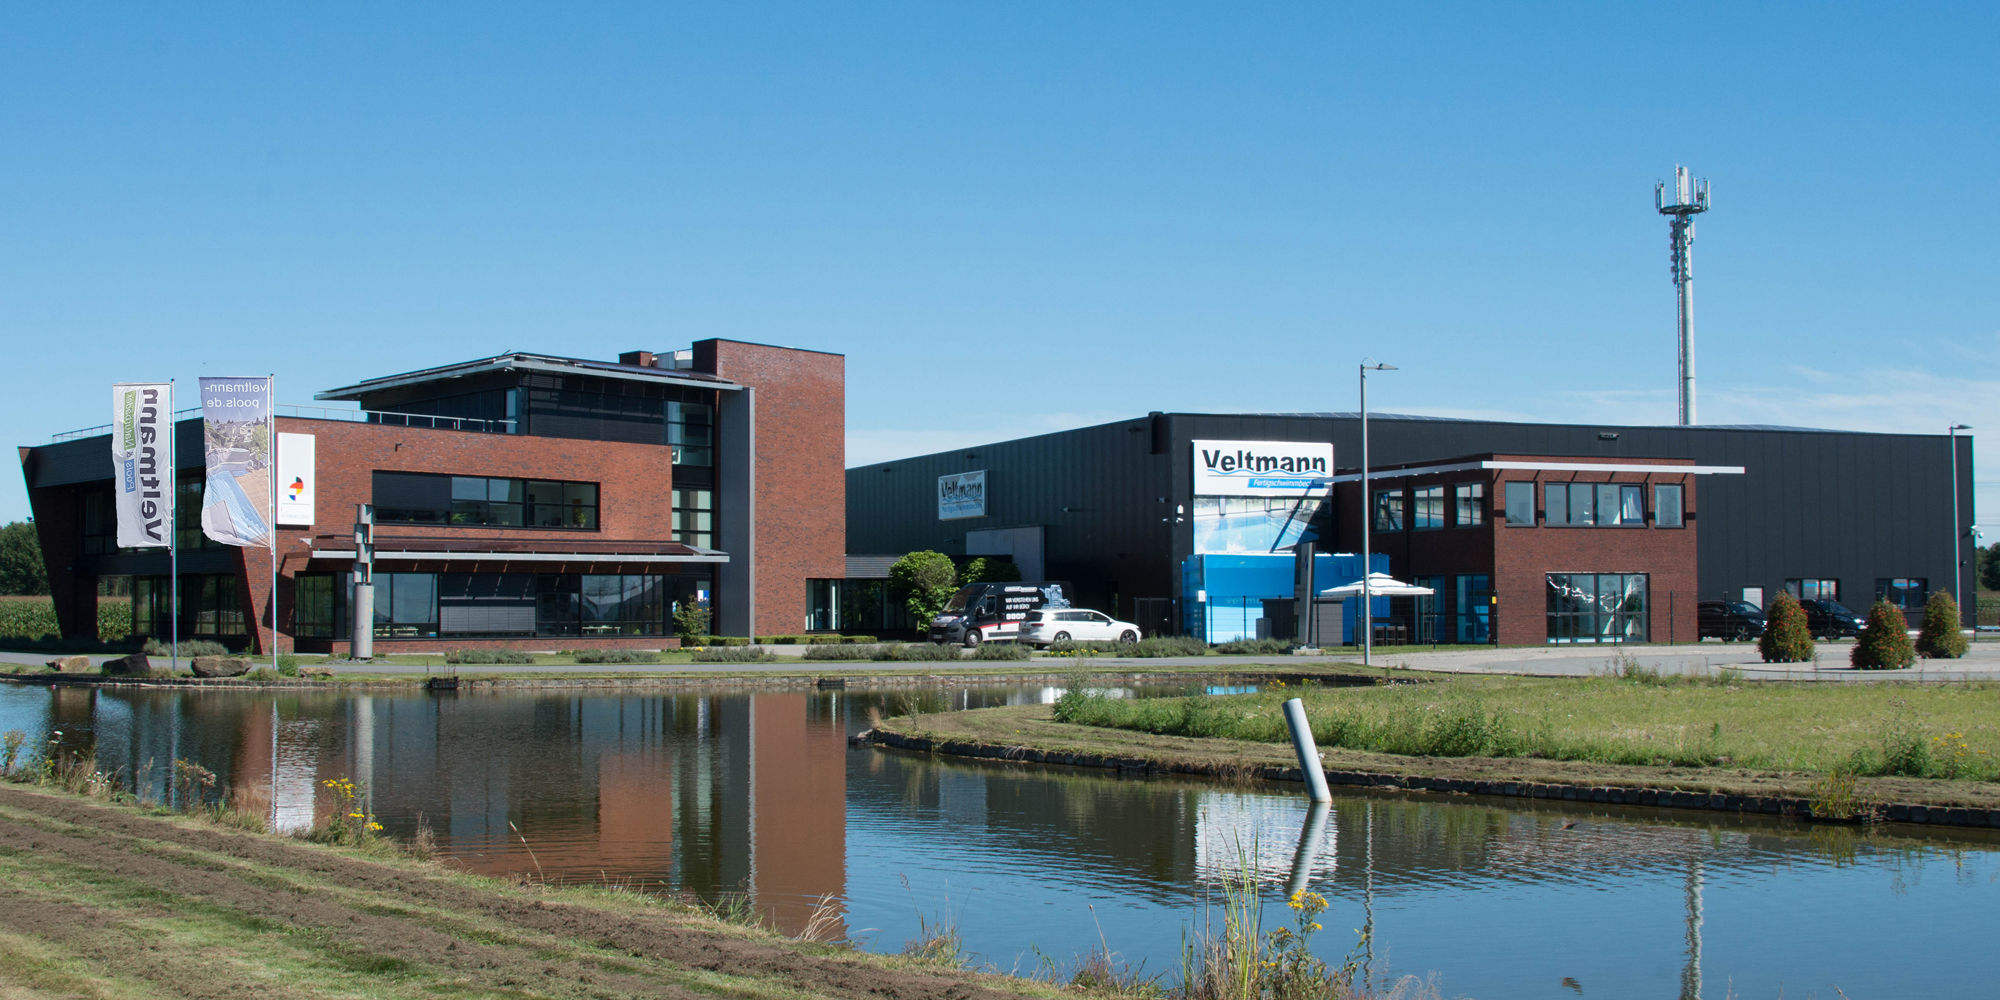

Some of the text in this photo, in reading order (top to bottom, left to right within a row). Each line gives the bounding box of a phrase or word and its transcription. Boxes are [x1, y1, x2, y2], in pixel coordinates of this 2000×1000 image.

[1202, 449, 1326, 472] Veltmann
[941, 480, 982, 499] Veltmann
[1253, 479, 1320, 488] Fertigschwimmbec
